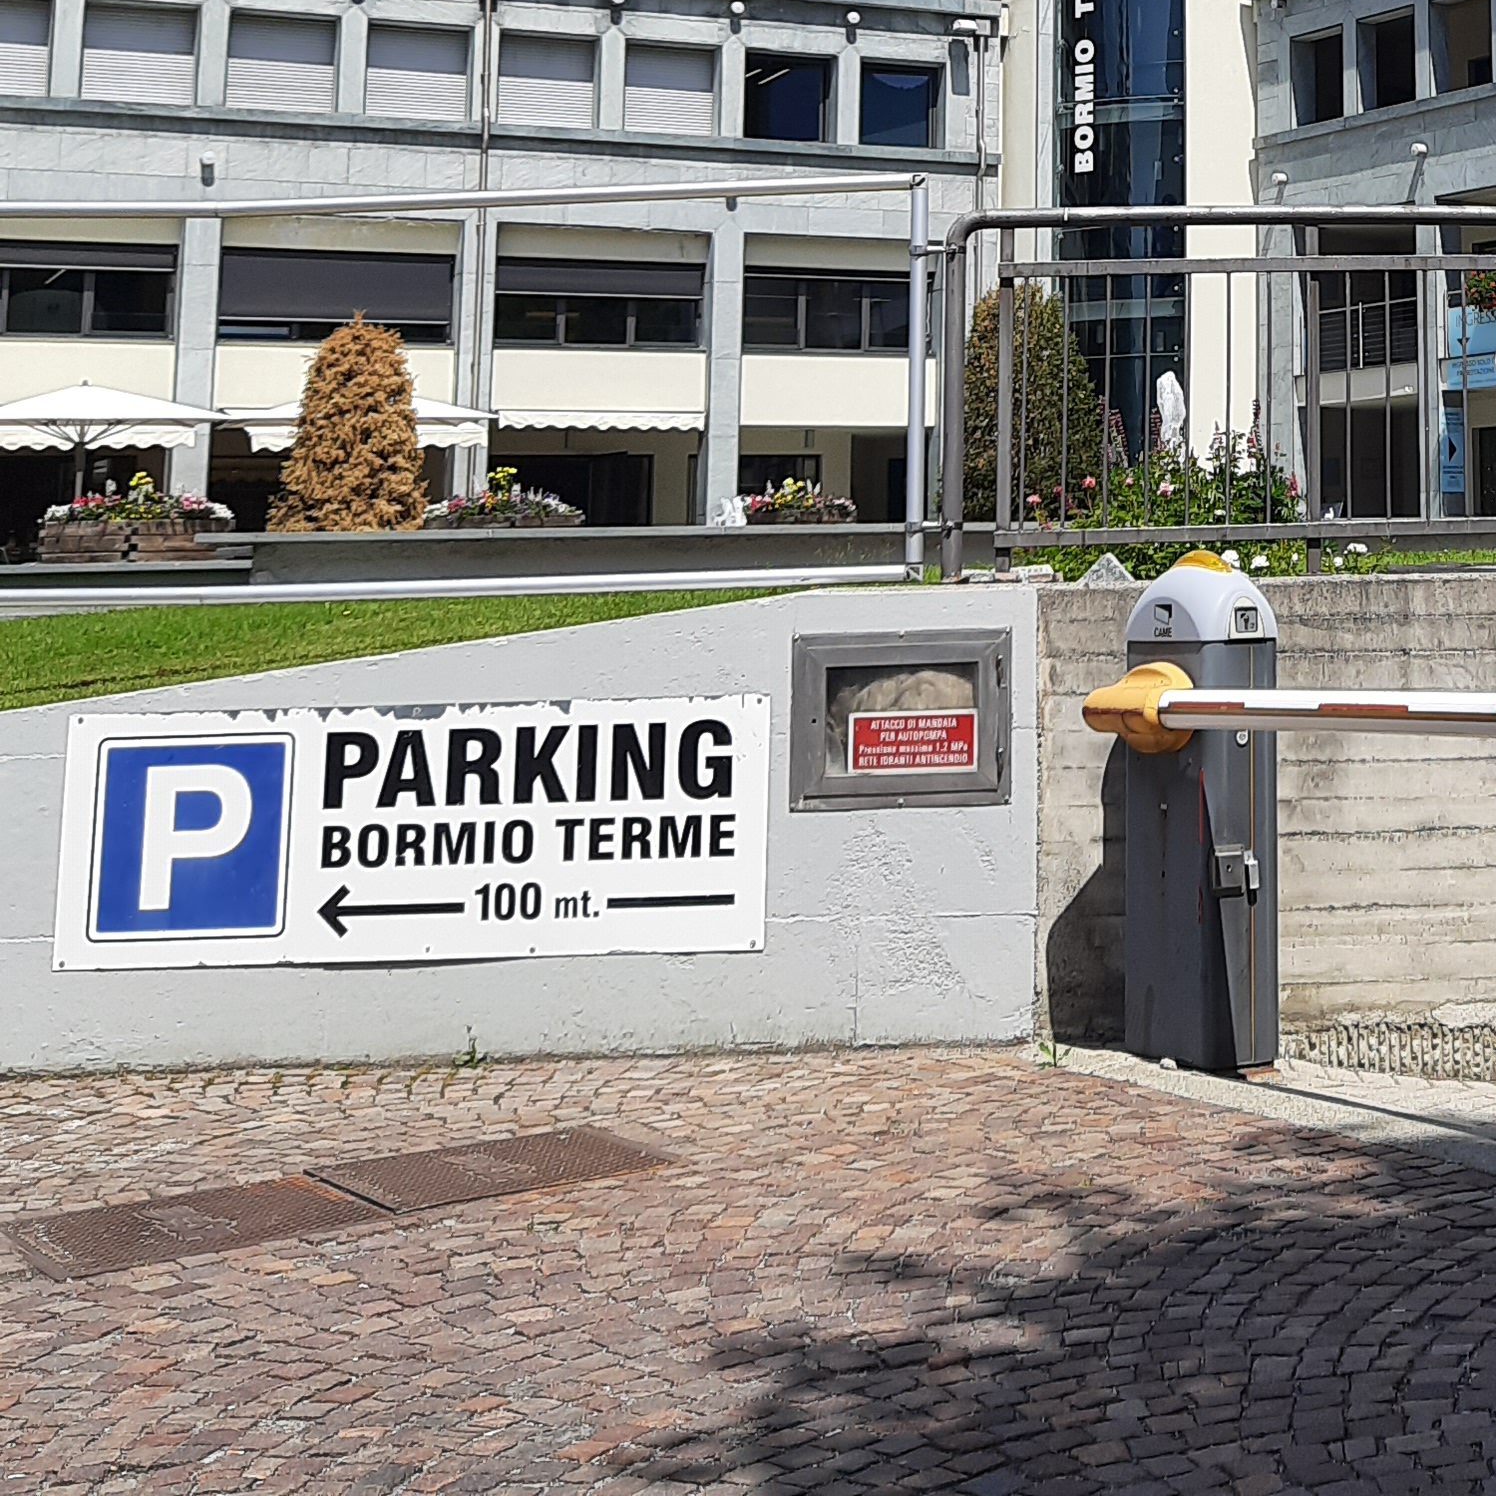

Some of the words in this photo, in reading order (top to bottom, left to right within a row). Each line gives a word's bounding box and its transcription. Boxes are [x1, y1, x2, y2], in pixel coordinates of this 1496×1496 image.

[1074, 39, 1095, 174] BORMIO
[1153, 626, 1173, 638] CAME
[870, 718, 906, 730] ATTACCO
[907, 719, 916, 729] DI
[918, 717, 958, 729] MANDATA
[879, 731, 896, 742] PER
[897, 730, 947, 741] AUTOPOMPA
[322, 719, 733, 810] PARKING
[858, 756, 879, 767] RETE
[880, 754, 913, 766] IDRANTI
[914, 753, 968, 765] ANTINCENDIO
[139, 764, 252, 911] P
[320, 819, 534, 870] BORMIO
[555, 814, 737, 863] TERME
[474, 883, 542, 922] 100
[554, 890, 600, 921] mt.
